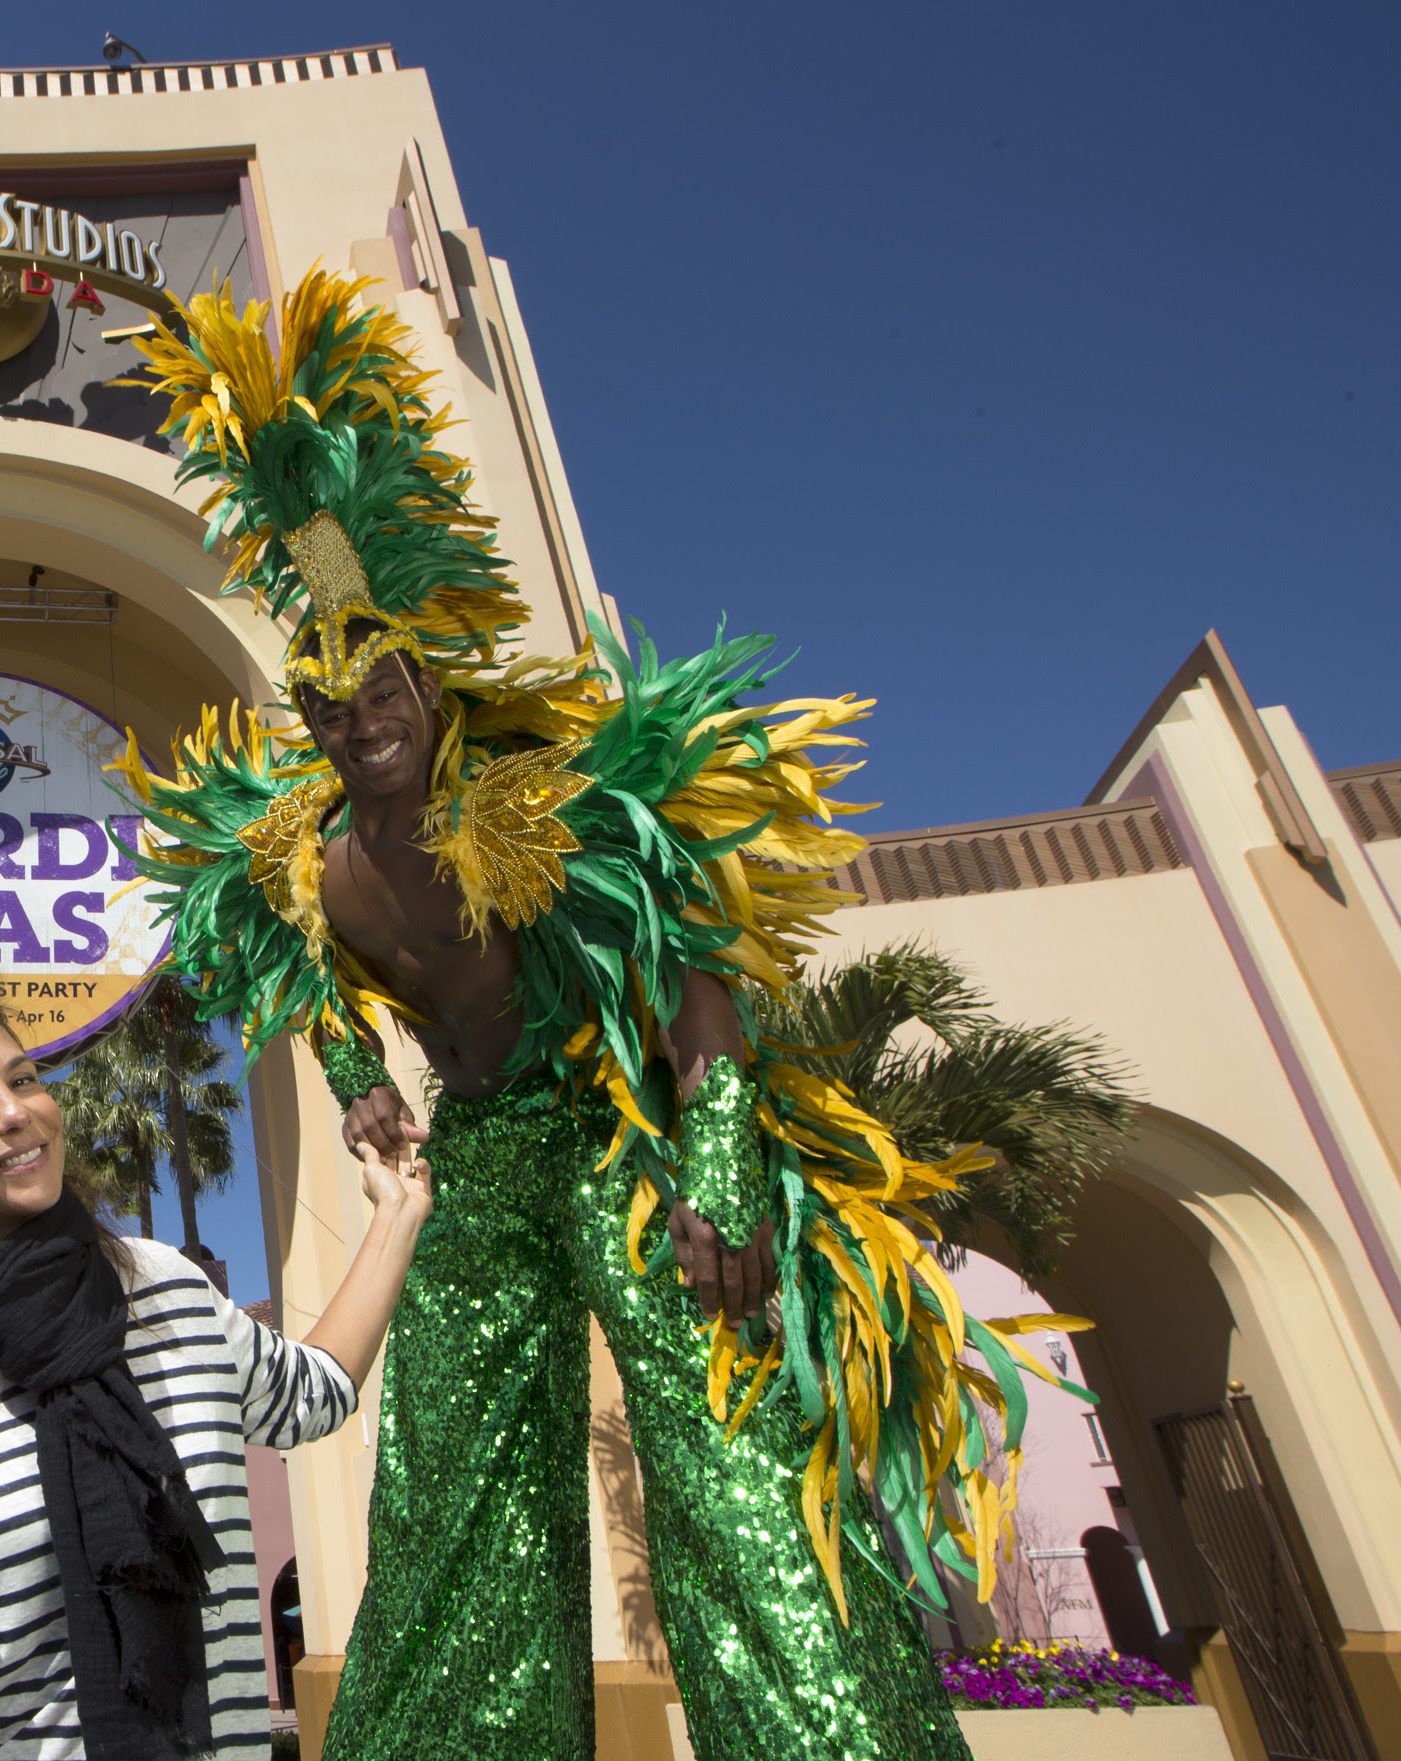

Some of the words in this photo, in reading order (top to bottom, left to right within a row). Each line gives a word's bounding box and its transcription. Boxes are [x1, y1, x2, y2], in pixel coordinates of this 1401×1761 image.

[28, 982, 97, 998] PARTY
[16, 1010, 44, 1026] Apr
[50, 1010, 65, 1022] 16
